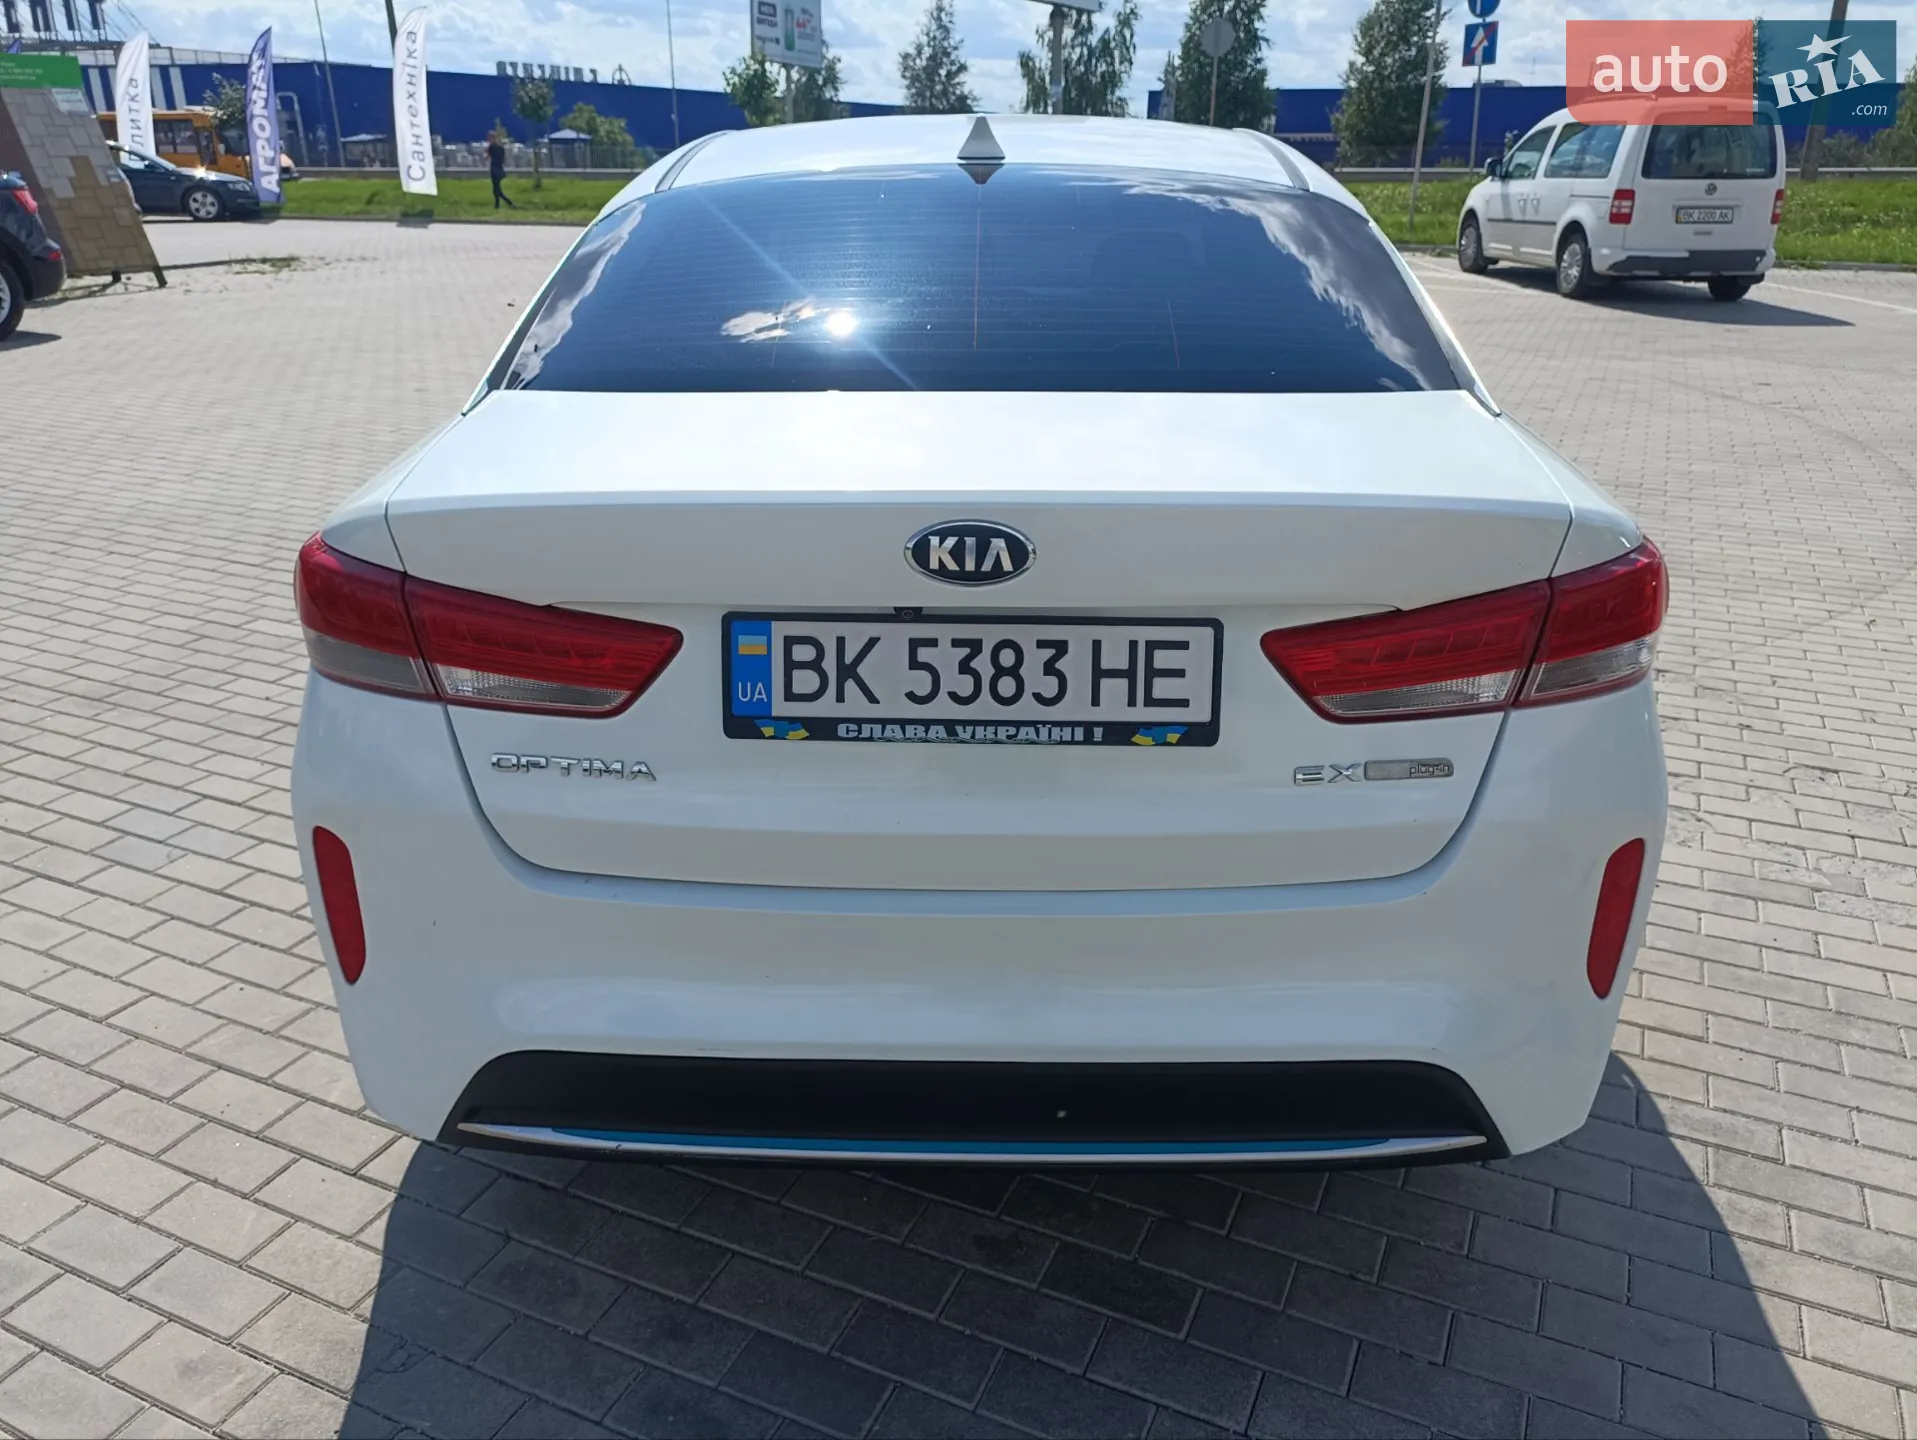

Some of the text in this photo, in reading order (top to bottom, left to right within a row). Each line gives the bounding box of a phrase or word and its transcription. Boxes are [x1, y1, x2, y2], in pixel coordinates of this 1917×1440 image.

[402, 30, 427, 182] Сантехніка
[928, 535, 1015, 573] KIA
[783, 635, 1191, 709] BK 5383 HE
[738, 681, 768, 703] UA
[837, 723, 948, 740] СЛАВА
[491, 752, 658, 782] OPTIMA
[1293, 762, 1450, 787] EX plug-in
